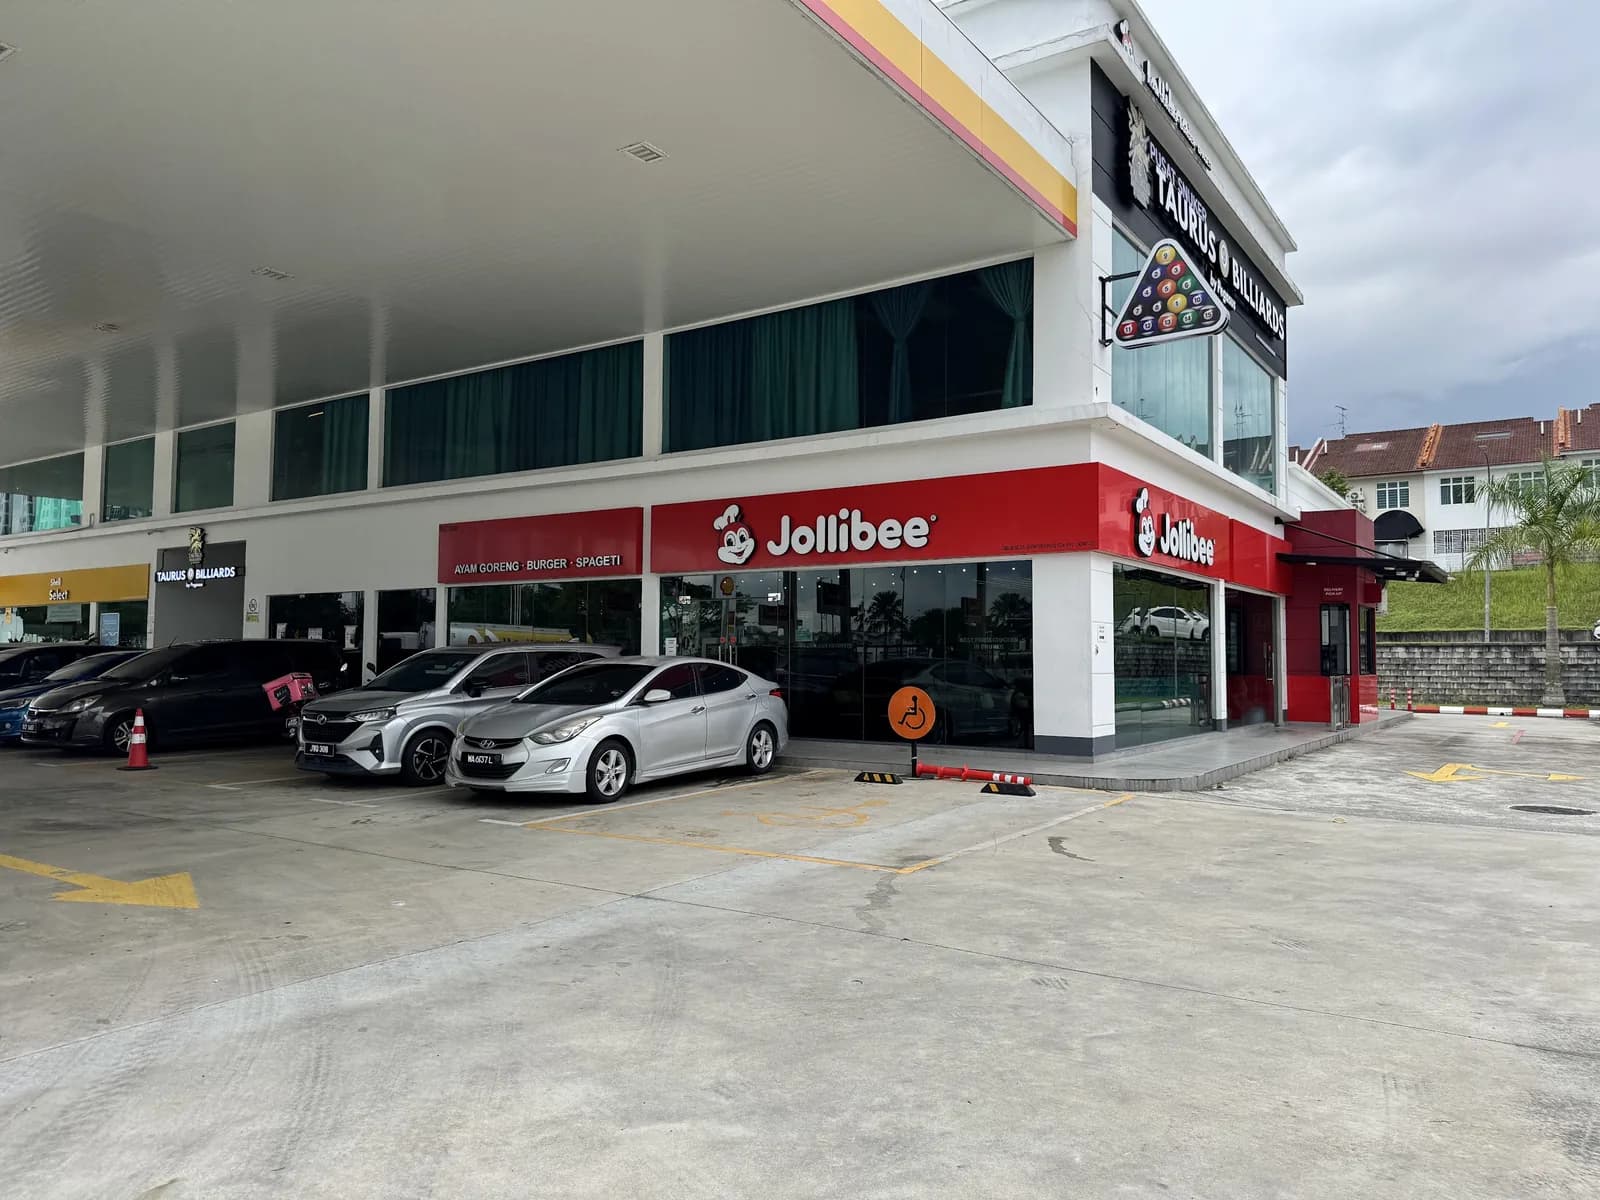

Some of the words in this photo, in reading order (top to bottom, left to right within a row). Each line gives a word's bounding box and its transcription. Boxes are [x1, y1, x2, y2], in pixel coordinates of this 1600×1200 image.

[1149, 141, 1177, 188] PUSAT
[1156, 165, 1217, 263] TAURUS
[1232, 257, 1285, 341] BILLIARDS
[767, 508, 929, 556] Jollibee
[1160, 512, 1214, 566] Jollibee
[156, 570, 187, 582] TAURUS
[195, 566, 236, 579] BILLIARDS
[454, 563, 478, 575] AYAM
[479, 560, 520, 574] GORENG
[526, 558, 567, 571] BURGER
[575, 554, 621, 568] SPAGETI
[49, 589, 69, 600] Select
